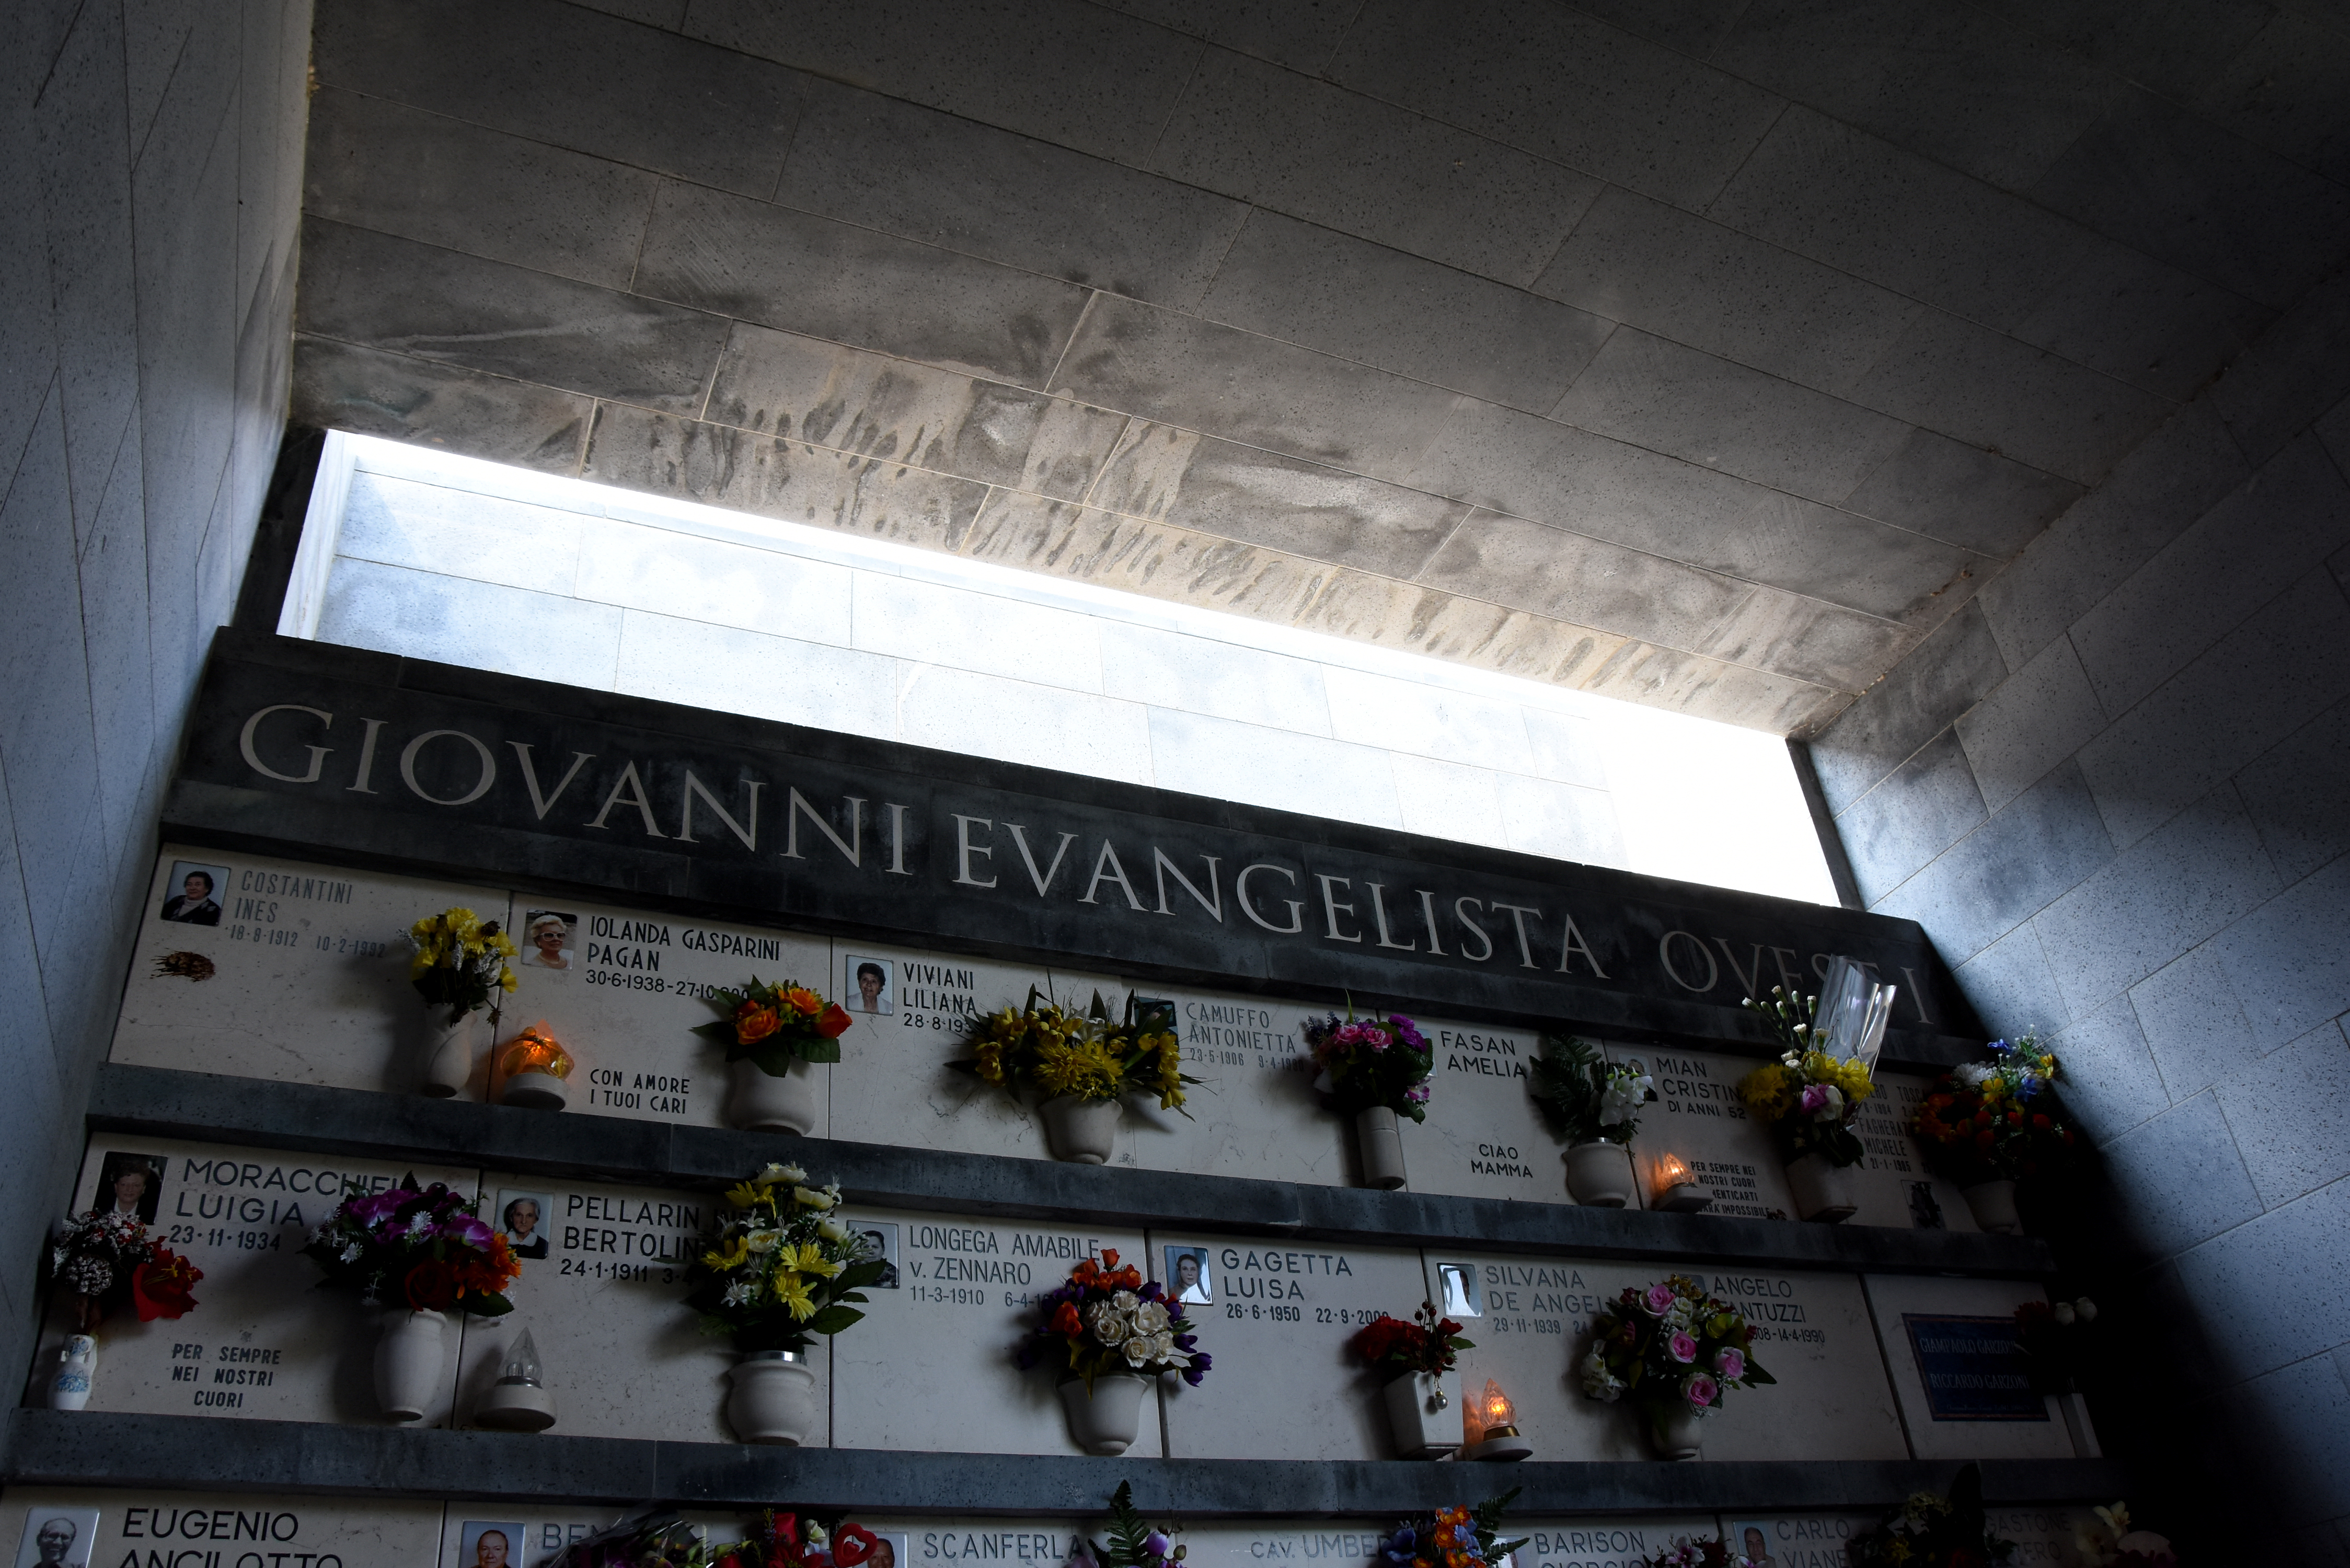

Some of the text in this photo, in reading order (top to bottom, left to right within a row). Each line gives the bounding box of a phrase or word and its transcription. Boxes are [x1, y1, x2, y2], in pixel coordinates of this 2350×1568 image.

[239, 704, 913, 875] GIOVANNI
[950, 813, 1612, 979] EVANGELISTA
[240, 870, 352, 904] COSTANTINI
[234, 897, 278, 924] INES
[590, 916, 780, 961] IOLANDA GASPARINI
[587, 942, 660, 972] PAGAN
[903, 962, 974, 990] VIVIANI
[903, 987, 977, 1014] LILIANA
[1186, 1002, 1270, 1029] CAMUFFO
[1189, 1025, 1296, 1054] ANTONIETTA
[1441, 1030, 1516, 1056] FASAN
[1447, 1054, 1528, 1080] AMELIA
[1656, 1056, 1708, 1078] MIAN
[590, 1068, 690, 1094] CON AMORE
[1662, 1078, 1747, 1102] CRISTIN
[590, 1089, 686, 1114] I TUOI CARI
[1667, 1100, 1747, 1120] DI ANNI 52
[1858, 1116, 1912, 1138] FAGHERAZ
[1478, 1143, 1519, 1160] CIAO
[1864, 1137, 1907, 1157] MICHELE
[1470, 1160, 1534, 1179] MAMMA
[1690, 1161, 1756, 1177] PER SEMPRE NEI
[1698, 1174, 1756, 1189] NOSTRI CUORI
[176, 1191, 304, 1227] LUIGIA
[567, 1194, 700, 1230] PELLARIN
[909, 1225, 1101, 1261] LONGEGA AMABILE
[909, 1256, 1031, 1286] v. ZENNARO
[1221, 1248, 1353, 1277] GAGETTA
[1224, 1276, 1305, 1300] LUISA
[1485, 1265, 1586, 1289] SILVANA
[1714, 1275, 1793, 1298] ANGELO
[910, 1285, 985, 1306] 11-3-1910
[1489, 1290, 1613, 1315] DE ANGEL
[172, 1343, 282, 1365] PER SEMPRE
[1919, 1337, 1977, 1354] GIAMPAOLO
[172, 1366, 274, 1387] NEI NOSTRI
[1929, 1373, 2031, 1389] RICCARDO GARZONI
[193, 1390, 243, 1408] CUORI
[122, 1507, 299, 1541] EUGENIO
[1777, 1518, 1850, 1541] CARLO
[1984, 1511, 2072, 1534] GASTONE
[1250, 1539, 1295, 1559] CAV.
[1534, 1530, 1646, 1555] BARISON
